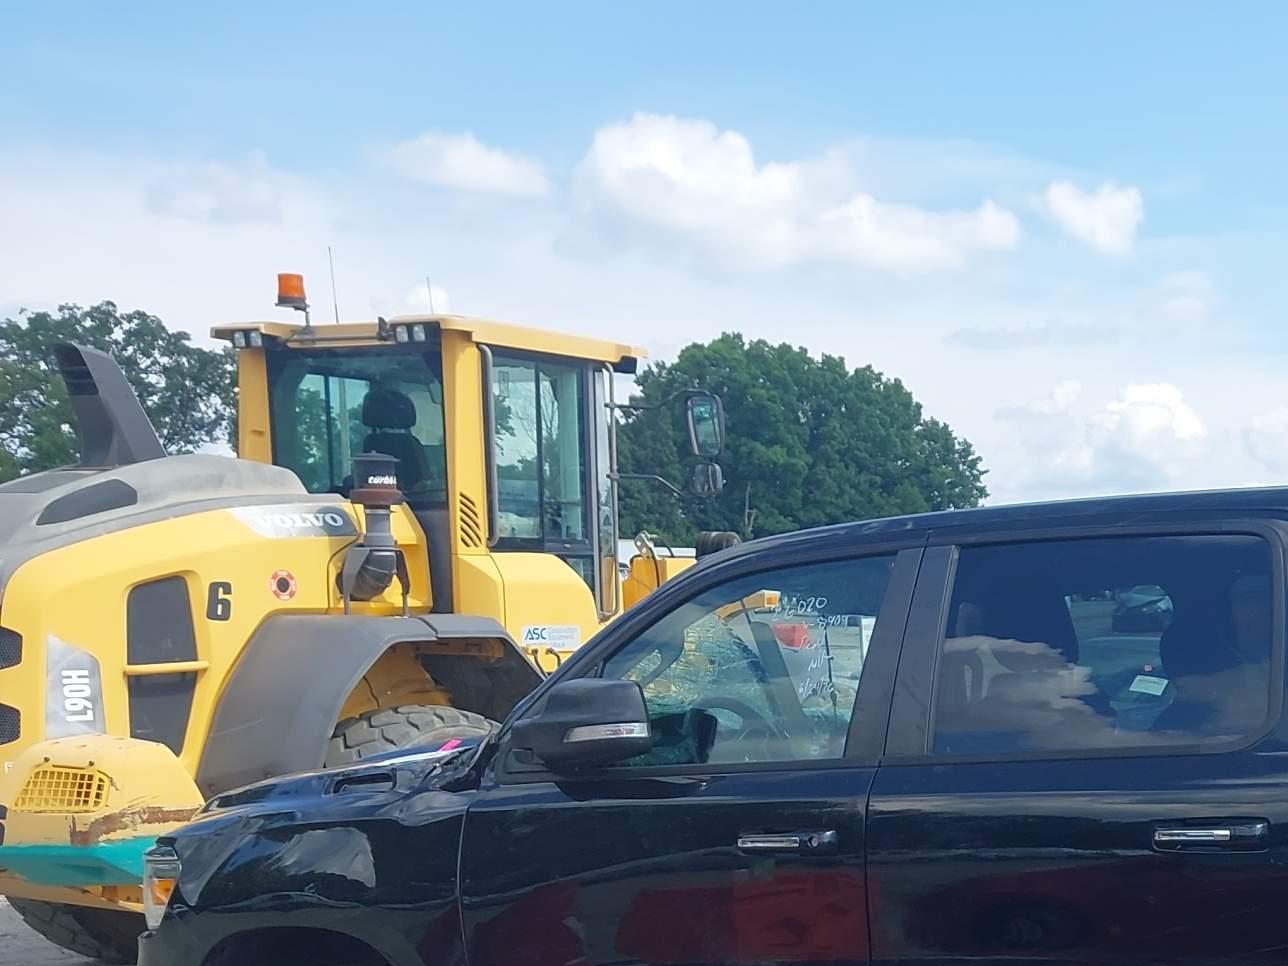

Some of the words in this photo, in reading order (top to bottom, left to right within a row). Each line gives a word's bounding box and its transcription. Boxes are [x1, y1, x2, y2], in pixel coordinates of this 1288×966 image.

[253, 512, 344, 528] VOLVO
[206, 581, 233, 621] 6
[525, 627, 547, 641] ASC
[61, 669, 94, 722] L90H
